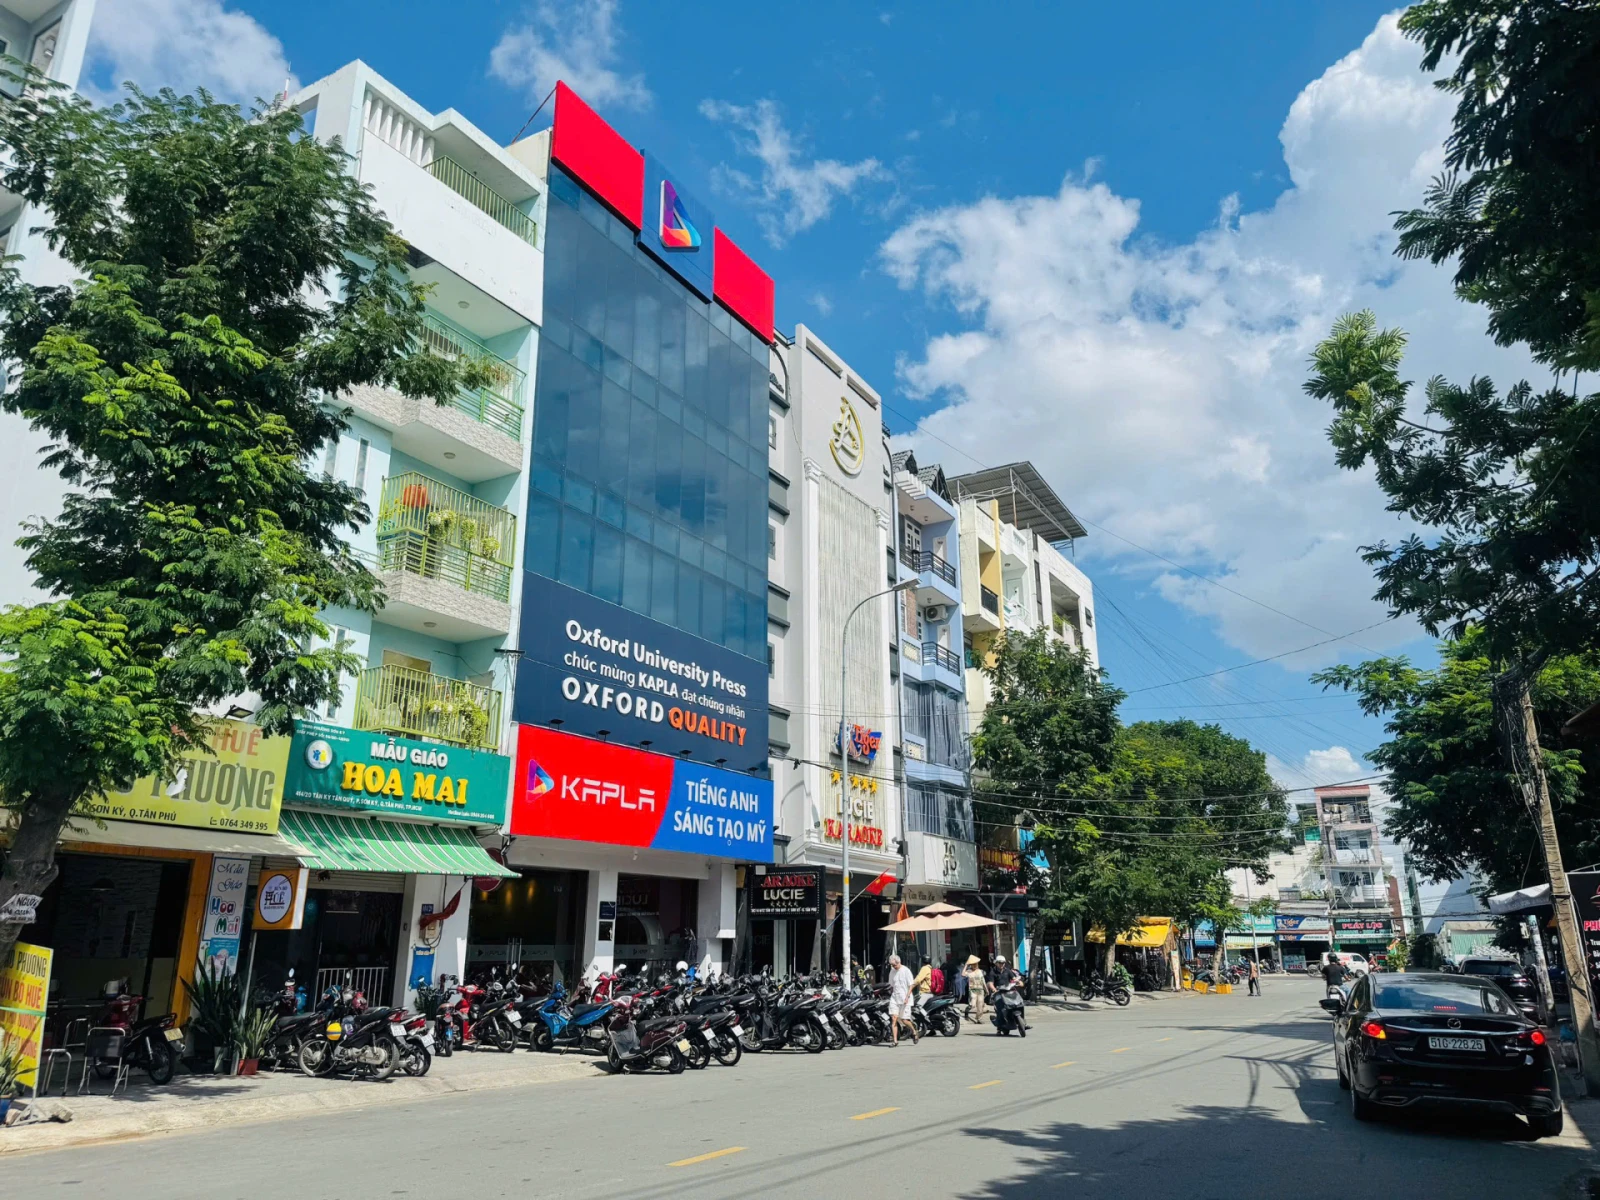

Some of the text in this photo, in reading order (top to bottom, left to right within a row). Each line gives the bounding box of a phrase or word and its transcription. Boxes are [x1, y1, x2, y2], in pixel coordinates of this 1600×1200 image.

[565, 619, 746, 698] Oxford University Press
[564, 651, 746, 721] chúc mùng KAPLA đạt chúng nhận
[561, 677, 747, 747] OXFORD QUALITY
[371, 738, 448, 768] MẪU GIÁO
[853, 724, 881, 756] Tiger
[150, 757, 276, 811] HƯƠNG
[341, 762, 468, 805] HOA MAI
[561, 774, 655, 812] KAPLA
[685, 778, 759, 814] TIẾNG ANH
[129, 807, 157, 819] Q.TÂN
[158, 810, 177, 821] PHÚ
[219, 818, 268, 831] 0764 349 395
[673, 807, 766, 846] SÁNG TẠO MỸ
[210, 896, 236, 915] Hoa
[763, 888, 805, 901] LUCIE
[214, 916, 240, 935] Mai
[1584, 919, 1600, 931] PH
[1430, 1038, 1483, 1050] 51G-228.25
